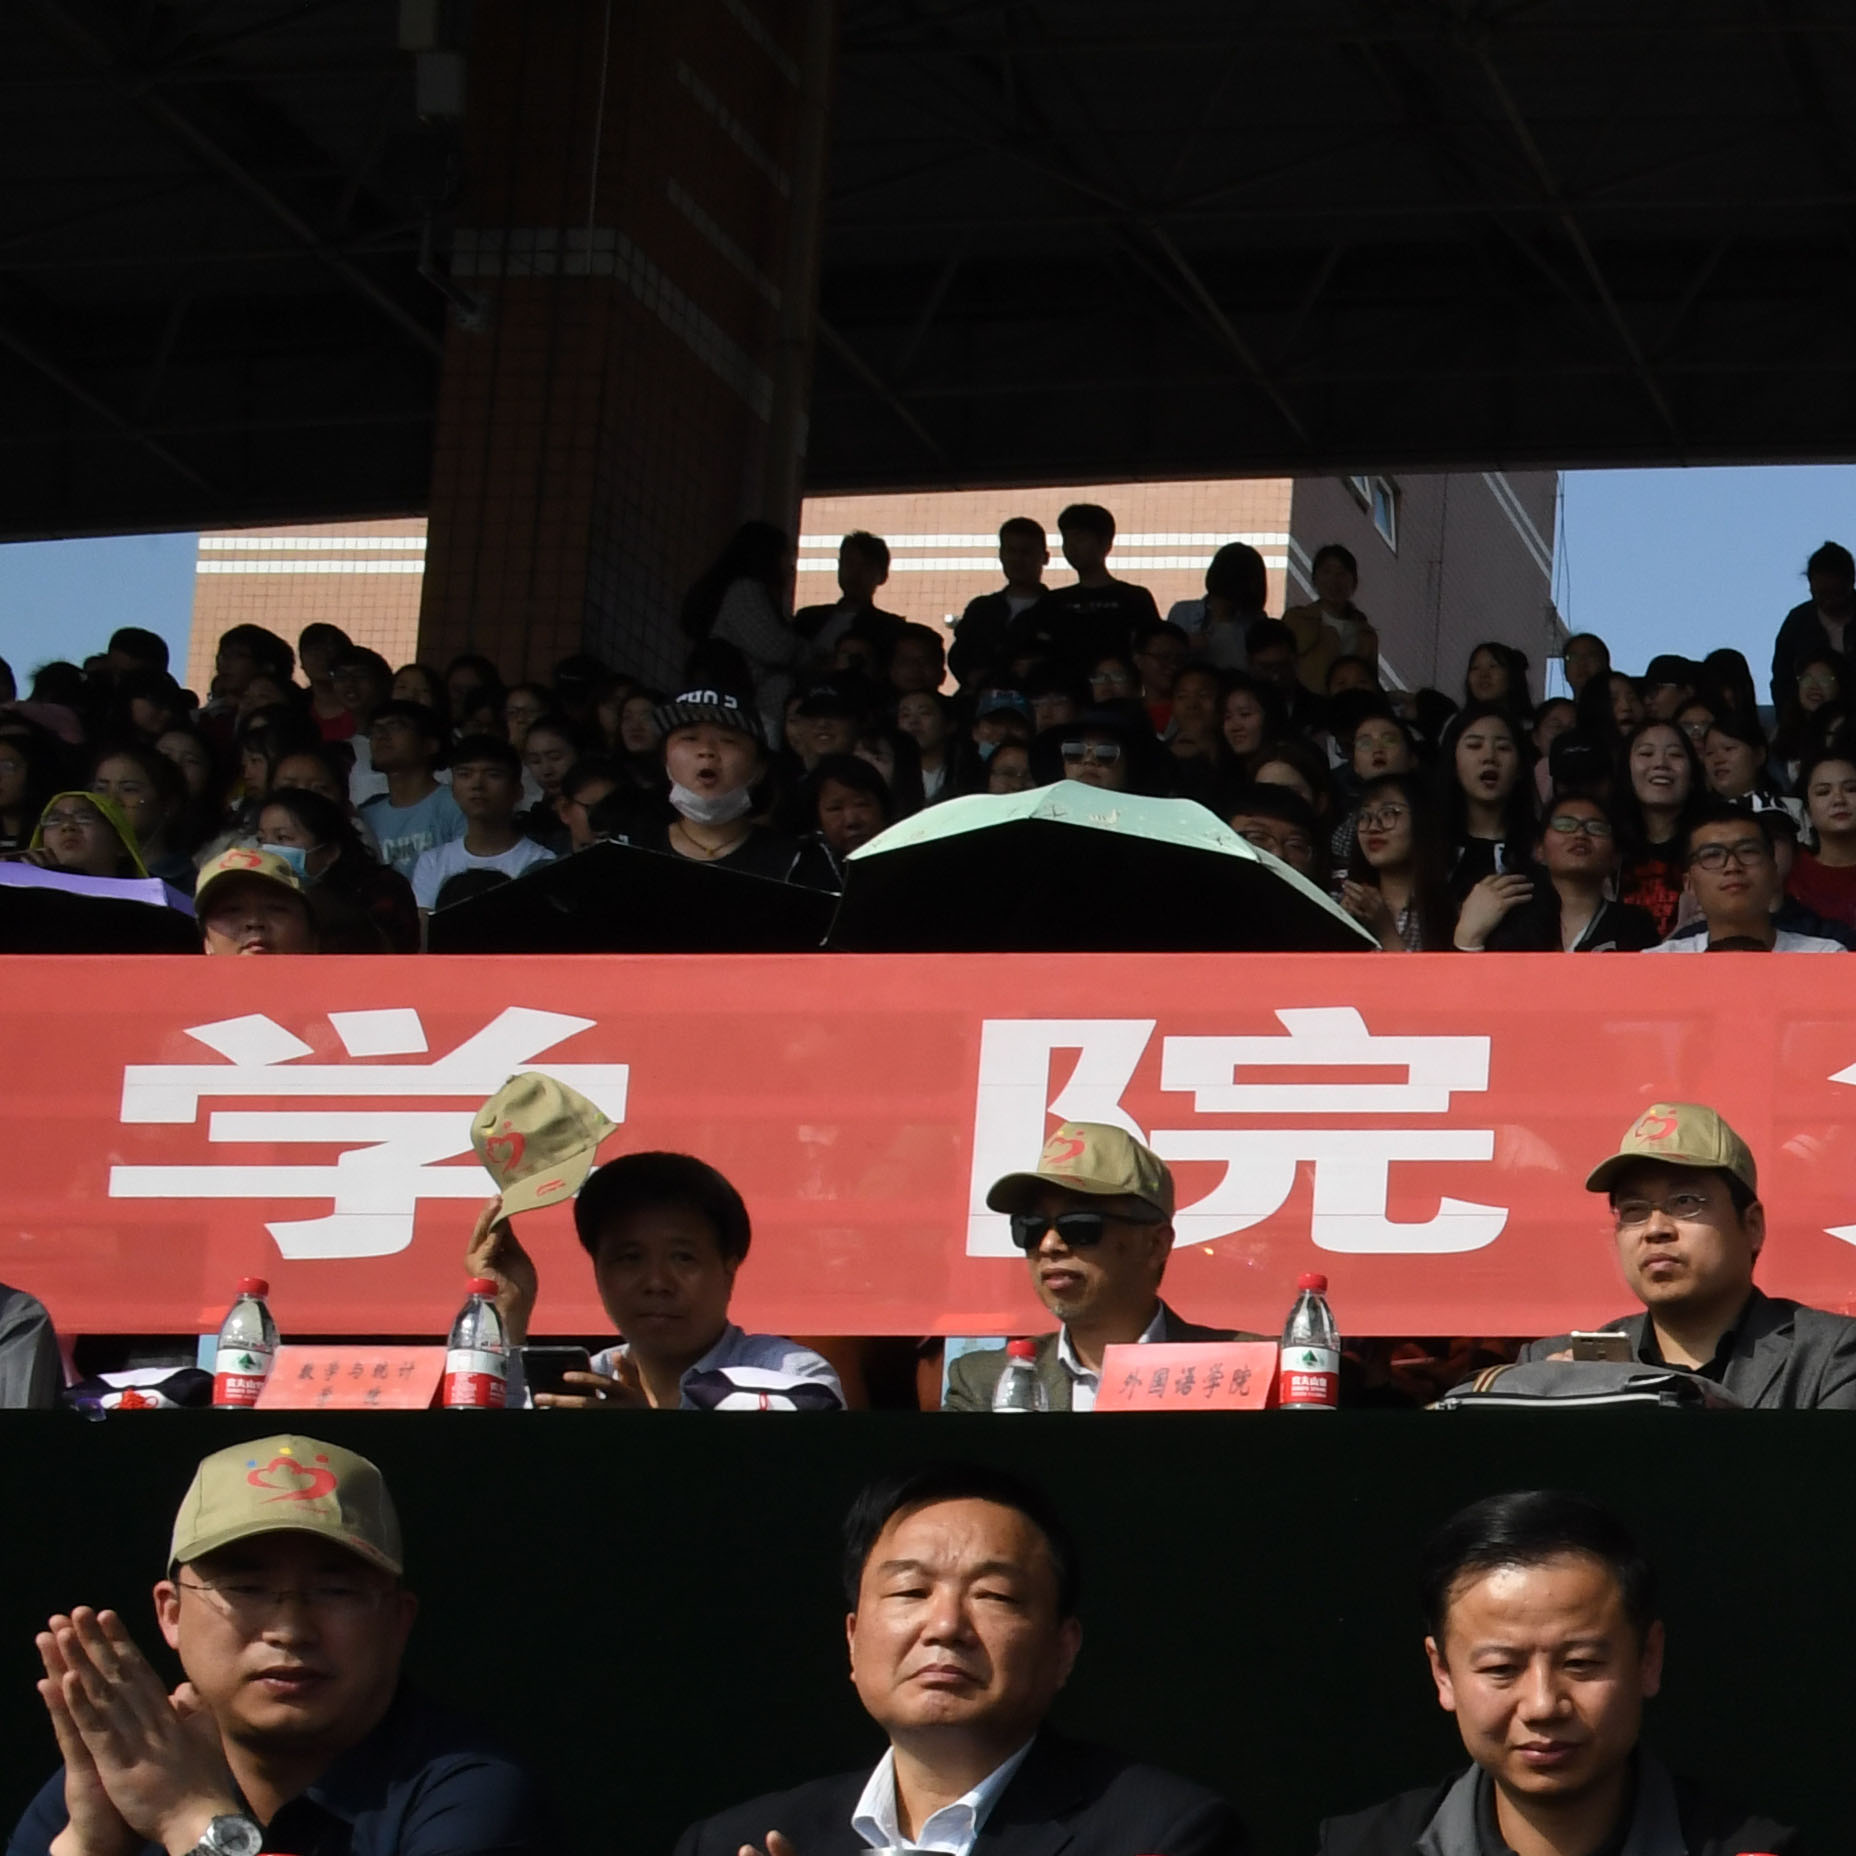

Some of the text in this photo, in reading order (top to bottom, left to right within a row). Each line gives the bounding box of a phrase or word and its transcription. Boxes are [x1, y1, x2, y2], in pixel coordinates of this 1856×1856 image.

[1119, 1362, 1252, 1399] 外国语学院
